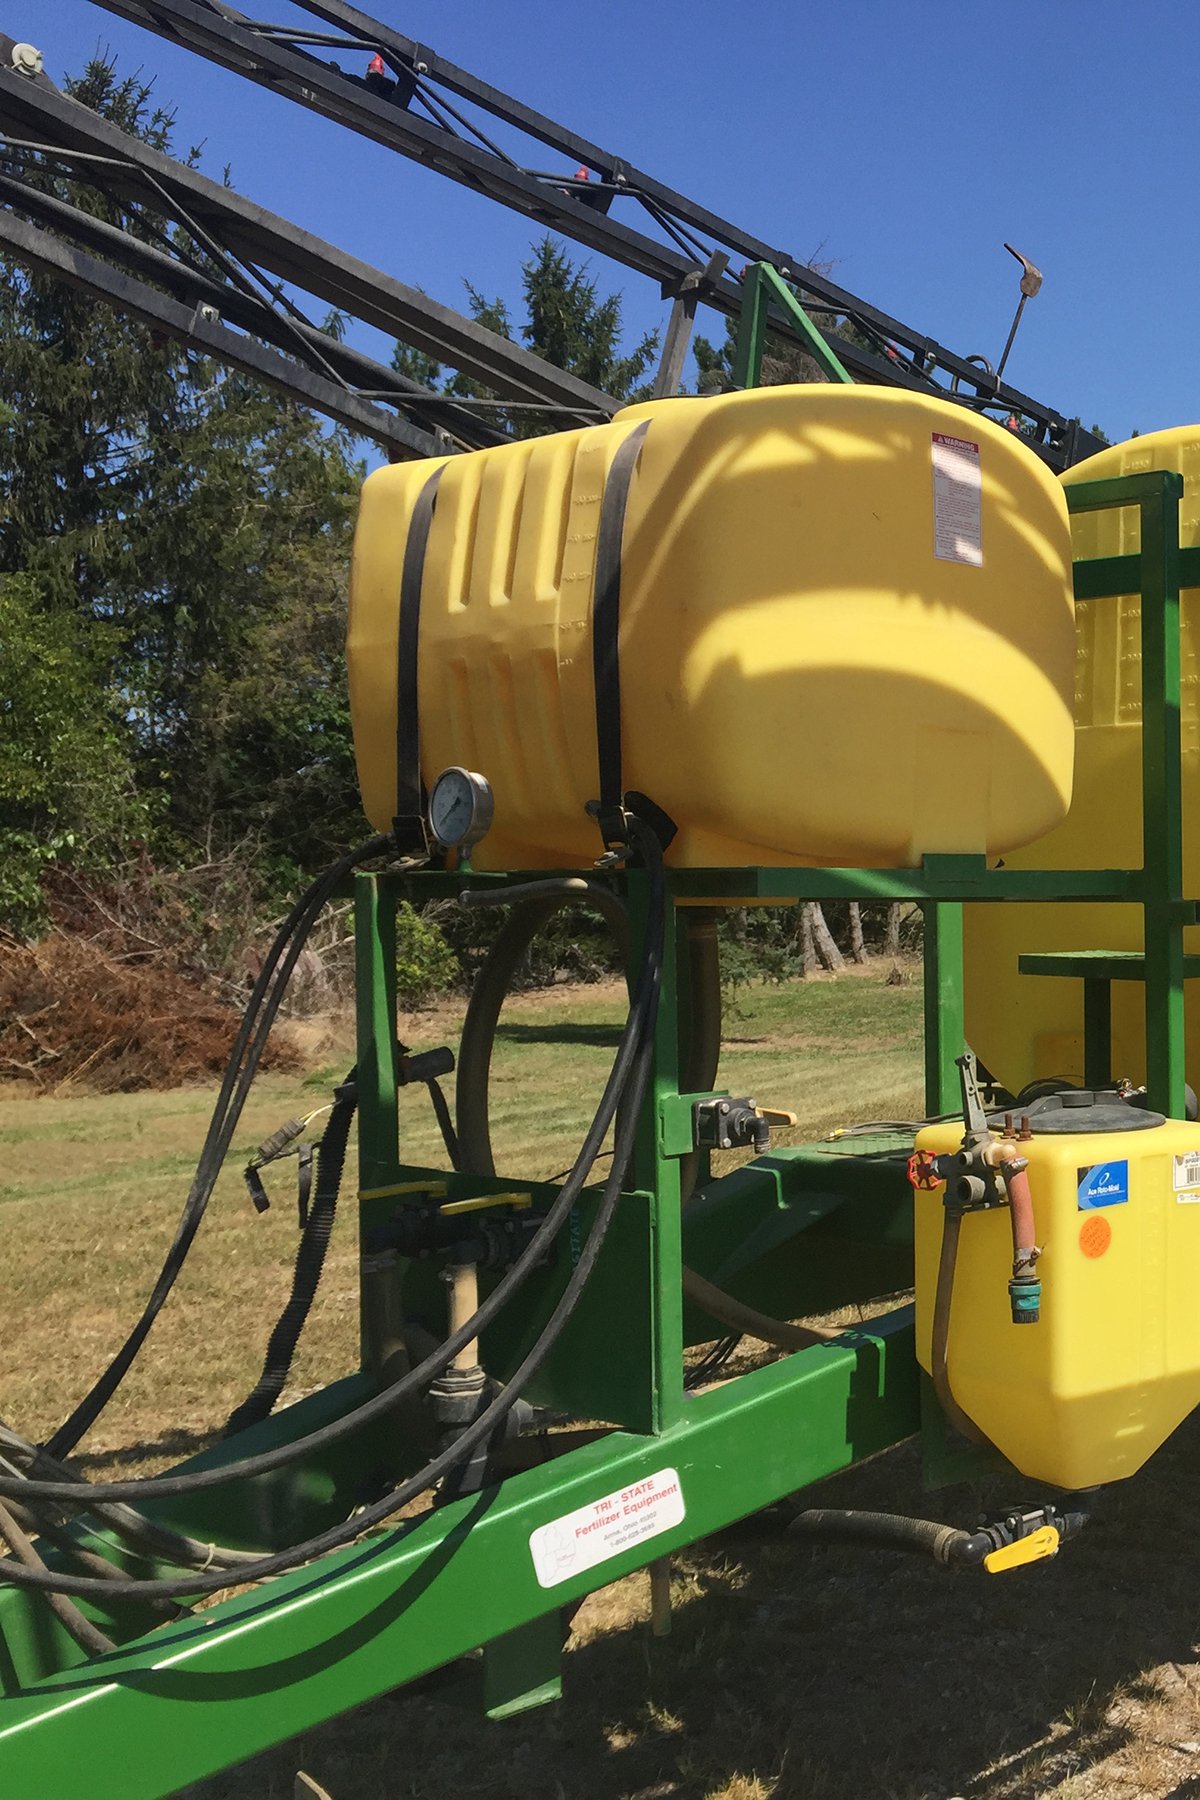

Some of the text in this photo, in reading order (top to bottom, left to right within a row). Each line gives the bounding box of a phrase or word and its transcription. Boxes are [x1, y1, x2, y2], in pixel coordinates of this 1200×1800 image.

[944, 436, 975, 451] WARNING
[574, 1483, 678, 1538] Fertilizer Equipment
[592, 1500, 612, 1515] TRI
[621, 1480, 655, 1502] STATE
